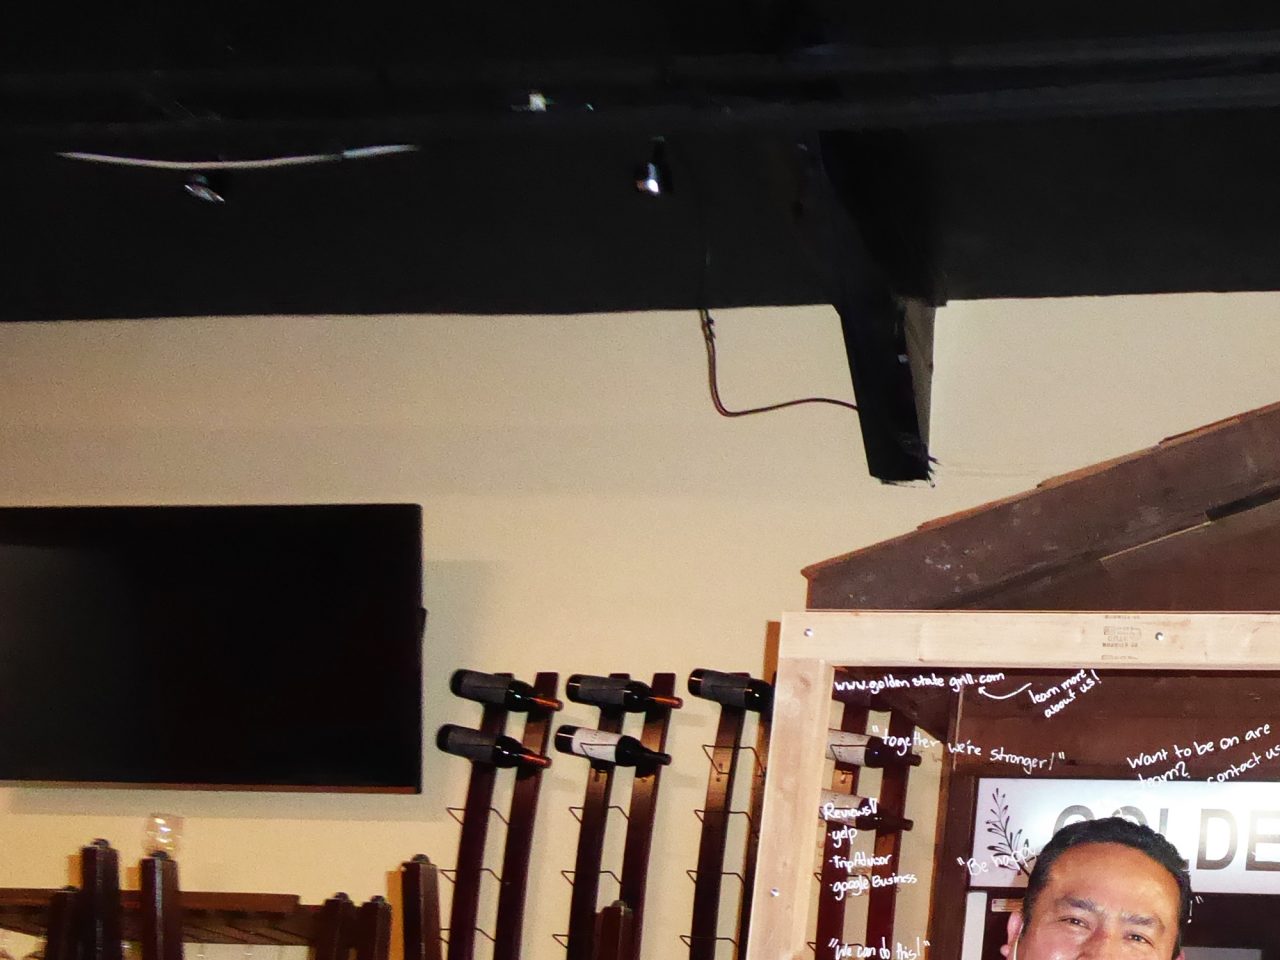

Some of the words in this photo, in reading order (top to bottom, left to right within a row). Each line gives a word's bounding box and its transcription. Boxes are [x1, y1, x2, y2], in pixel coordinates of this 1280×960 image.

[912, 672, 945, 687] state
[949, 672, 1005, 693] grill.com
[1028, 689, 1061, 704] learn
[1061, 669, 1087, 691] more
[1044, 691, 1077, 718] about
[1079, 669, 1102, 693] us!
[947, 739, 982, 756] we're
[1127, 749, 1168, 769] Want
[1174, 745, 1192, 759] to
[1194, 741, 1215, 756] be
[1219, 736, 1240, 750] on
[1245, 723, 1271, 742] are
[1207, 752, 1261, 784] contact
[832, 826, 857, 848] yelp
[832, 874, 869, 901] google
[872, 872, 918, 888] Business
[857, 945, 876, 958] can
[879, 936, 891, 960] do
